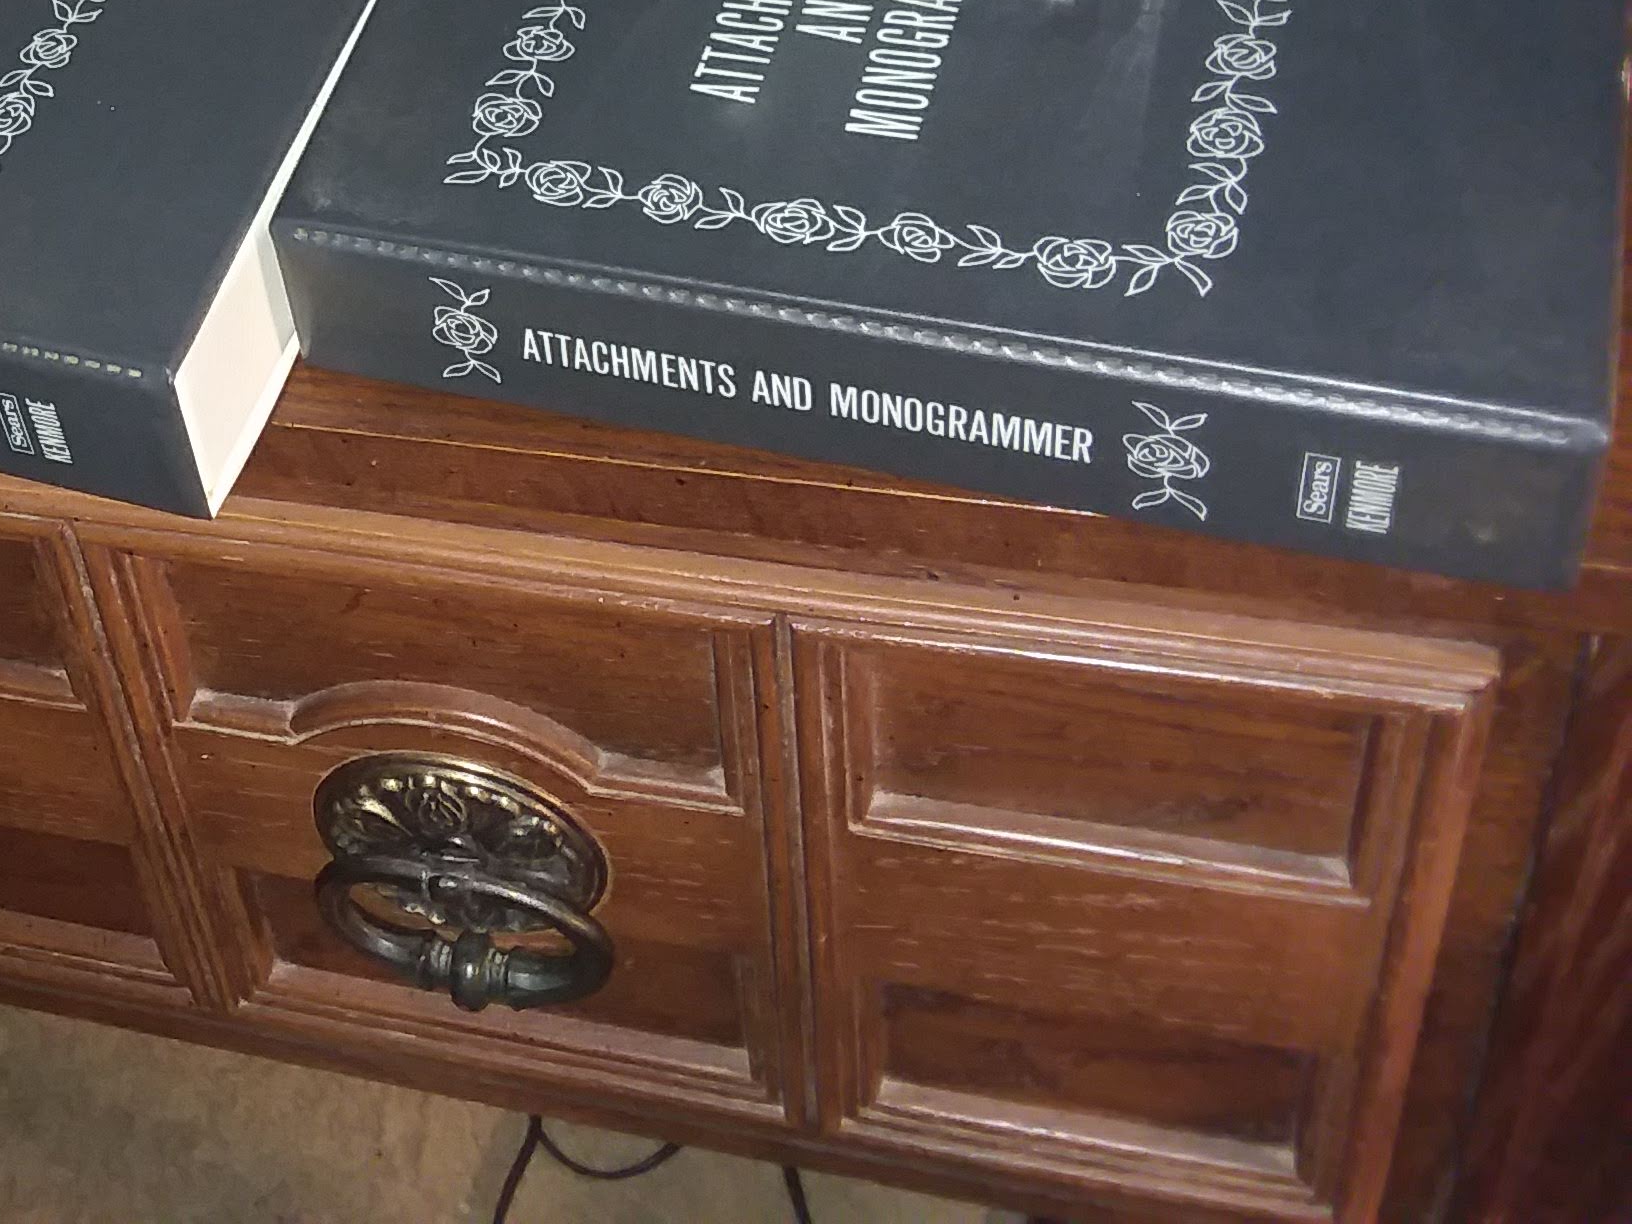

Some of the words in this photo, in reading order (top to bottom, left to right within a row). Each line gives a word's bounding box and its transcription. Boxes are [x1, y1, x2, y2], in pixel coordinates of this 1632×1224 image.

[1, 397, 28, 448] Sears
[523, 327, 737, 398] ATTACHMENTS
[752, 370, 812, 412] AND
[830, 382, 1094, 465] MONOGRAMMER
[24, 397, 73, 464] KENMORE
[1302, 459, 1334, 516] Sears
[1344, 459, 1400, 535] KENMORE
